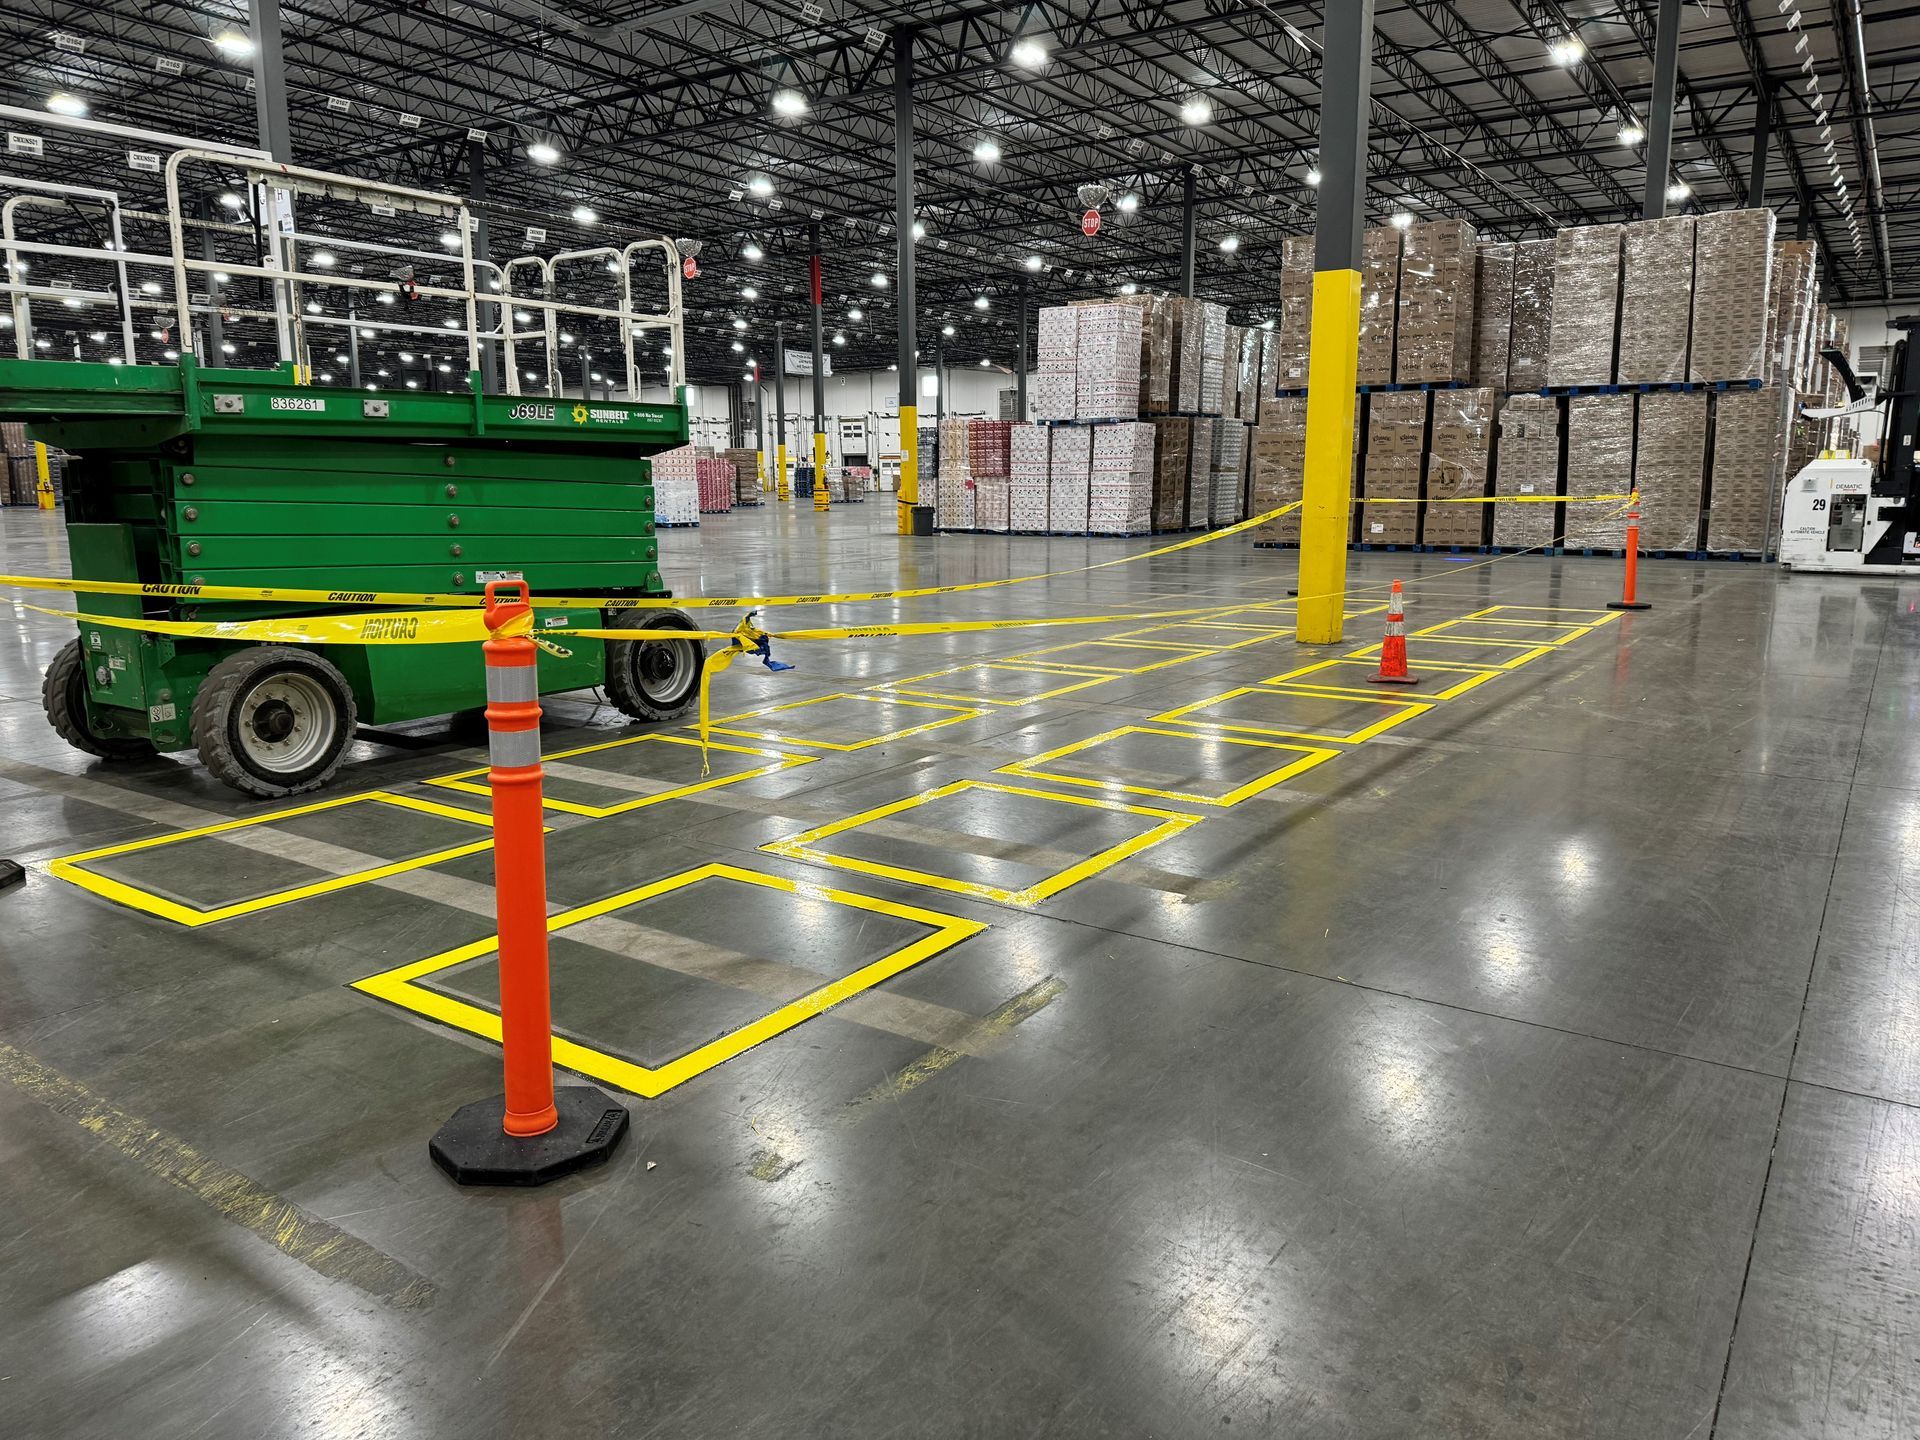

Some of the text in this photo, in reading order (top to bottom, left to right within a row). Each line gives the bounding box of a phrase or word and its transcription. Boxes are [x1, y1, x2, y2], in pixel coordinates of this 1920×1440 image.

[1084, 217, 1099, 228] STOP
[272, 397, 317, 410] 836261
[590, 409, 629, 420] SUNBELT
[1812, 498, 1826, 511] 29
[142, 584, 201, 595] CAUTION
[328, 592, 377, 602] CAUTION
[605, 599, 640, 607] CAUTION
